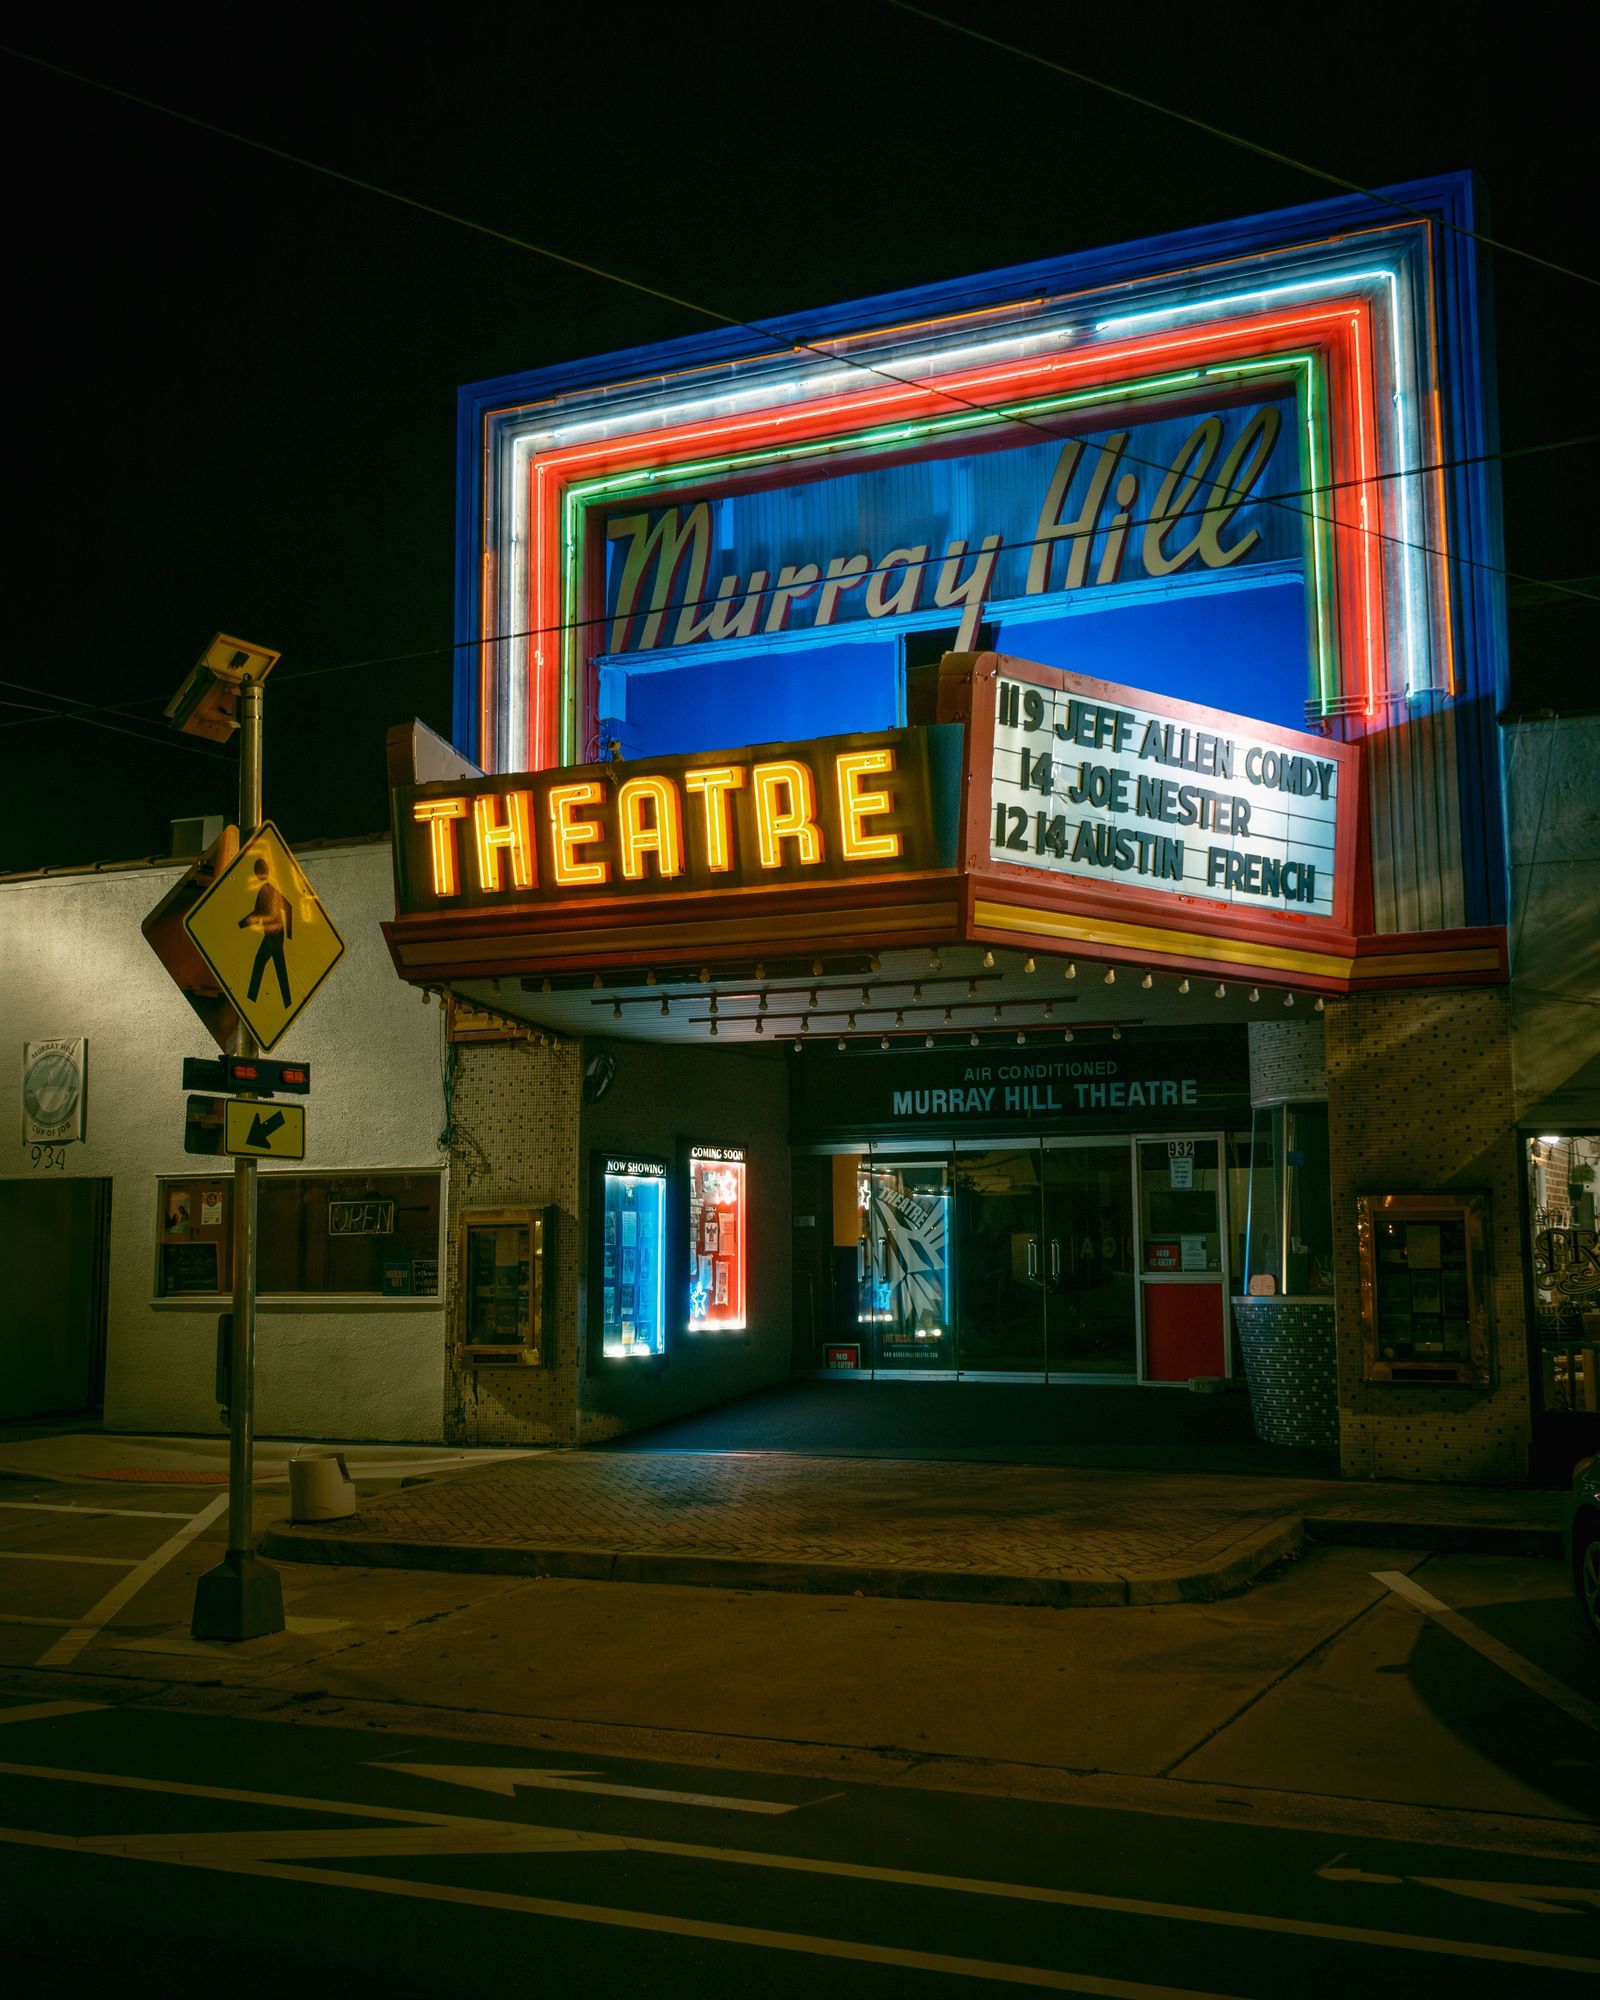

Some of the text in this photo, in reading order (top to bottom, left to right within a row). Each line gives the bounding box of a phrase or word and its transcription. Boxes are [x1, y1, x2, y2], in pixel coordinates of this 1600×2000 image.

[607, 405, 1281, 655] Murray Hill
[1055, 699, 1136, 753] JEFF
[1140, 720, 1235, 780] ALLEN
[1246, 746, 1335, 801] COMDY
[1021, 747, 1251, 838] 14 JOE NESTER
[414, 749, 903, 898] THEATRE
[1071, 820, 1185, 882] AUSTIN
[1207, 845, 1316, 904] FRENCH
[31, 1042, 76, 1060] MURRAY HILL
[964, 1061, 1118, 1081] AIR CONDITIONED
[893, 1080, 1198, 1115] MURRAY HILL THEATRE
[31, 1122, 73, 1137] CUP OF JOB
[31, 1145, 66, 1170] 934
[691, 1147, 744, 1160] COMING SOON
[1169, 1141, 1193, 1156] 932
[607, 1160, 664, 1175] NOW SHOWING
[332, 1204, 393, 1232] OPEN
[880, 1187, 929, 1228] THEATRE
[836, 1353, 849, 1361] NO
